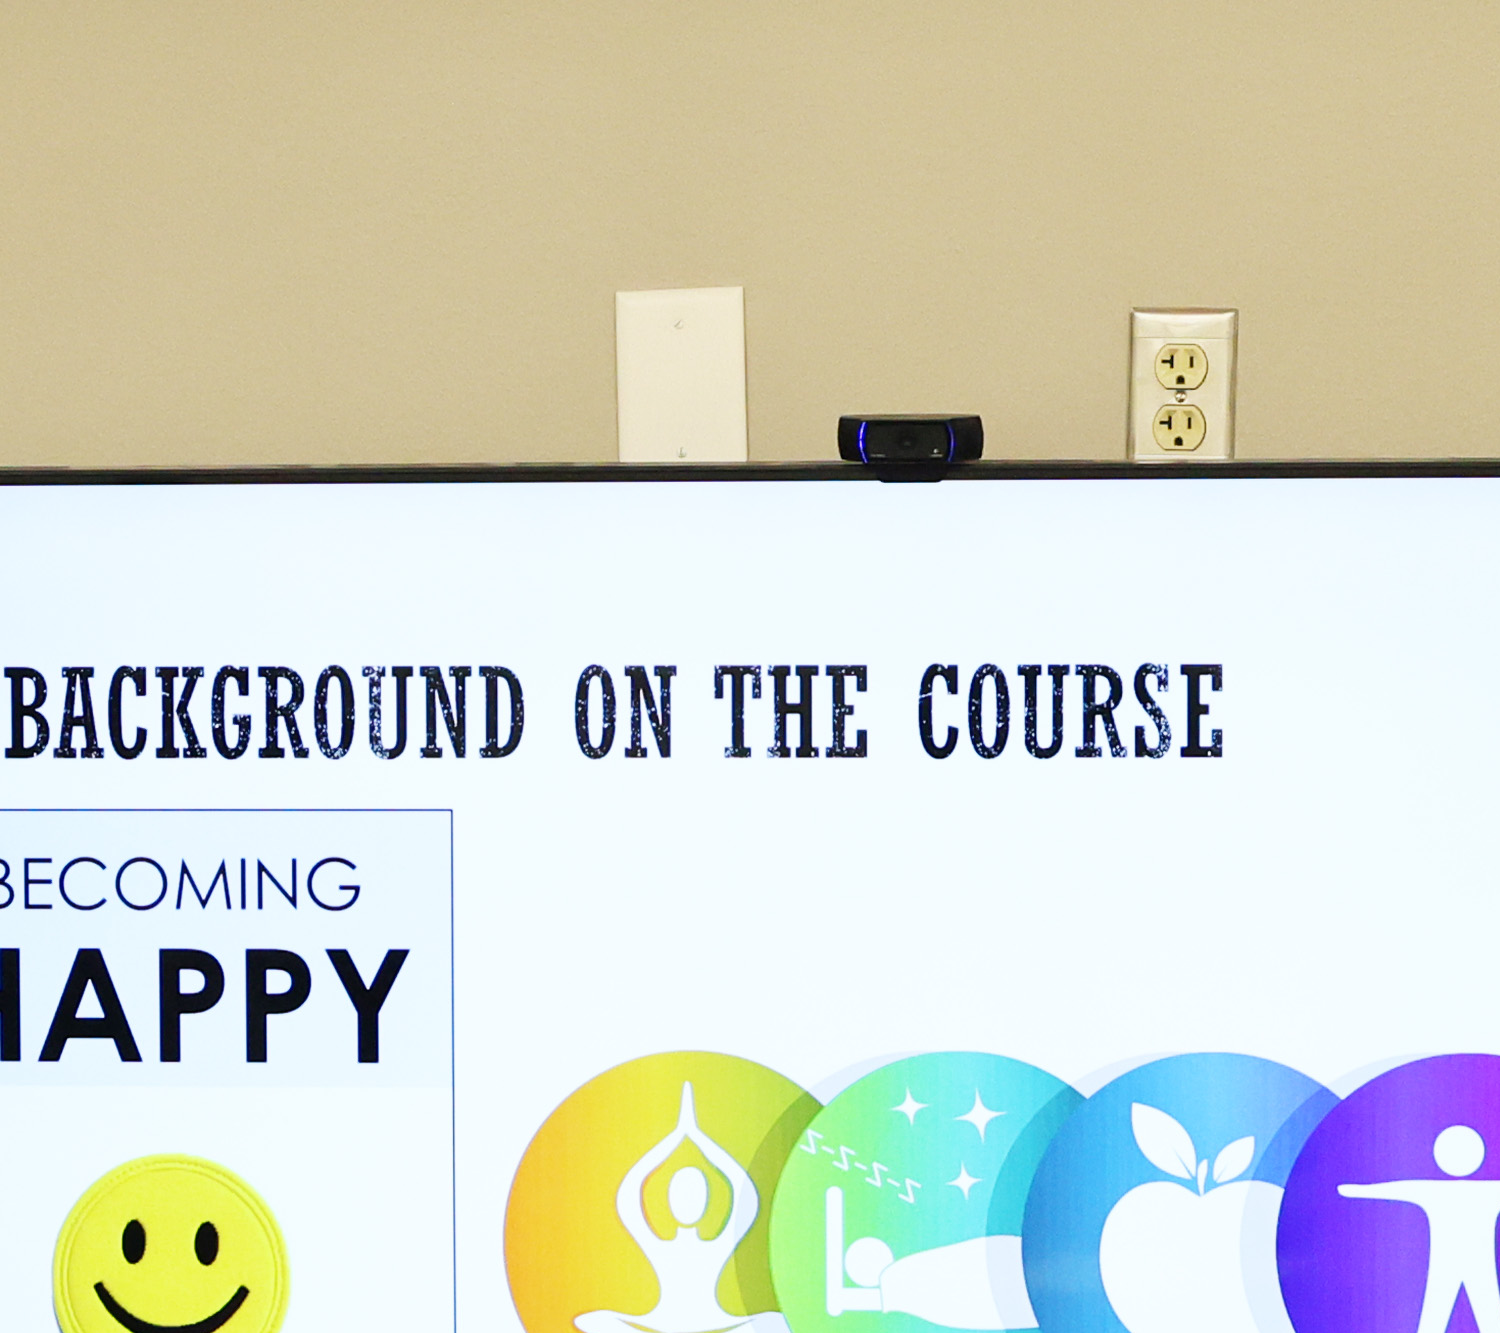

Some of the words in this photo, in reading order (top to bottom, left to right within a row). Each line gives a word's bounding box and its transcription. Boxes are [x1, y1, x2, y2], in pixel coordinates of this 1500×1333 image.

[4, 665, 524, 760] BACKGROUND
[575, 664, 677, 759] ON
[714, 665, 867, 758] THE
[919, 663, 1222, 759] COURSE
